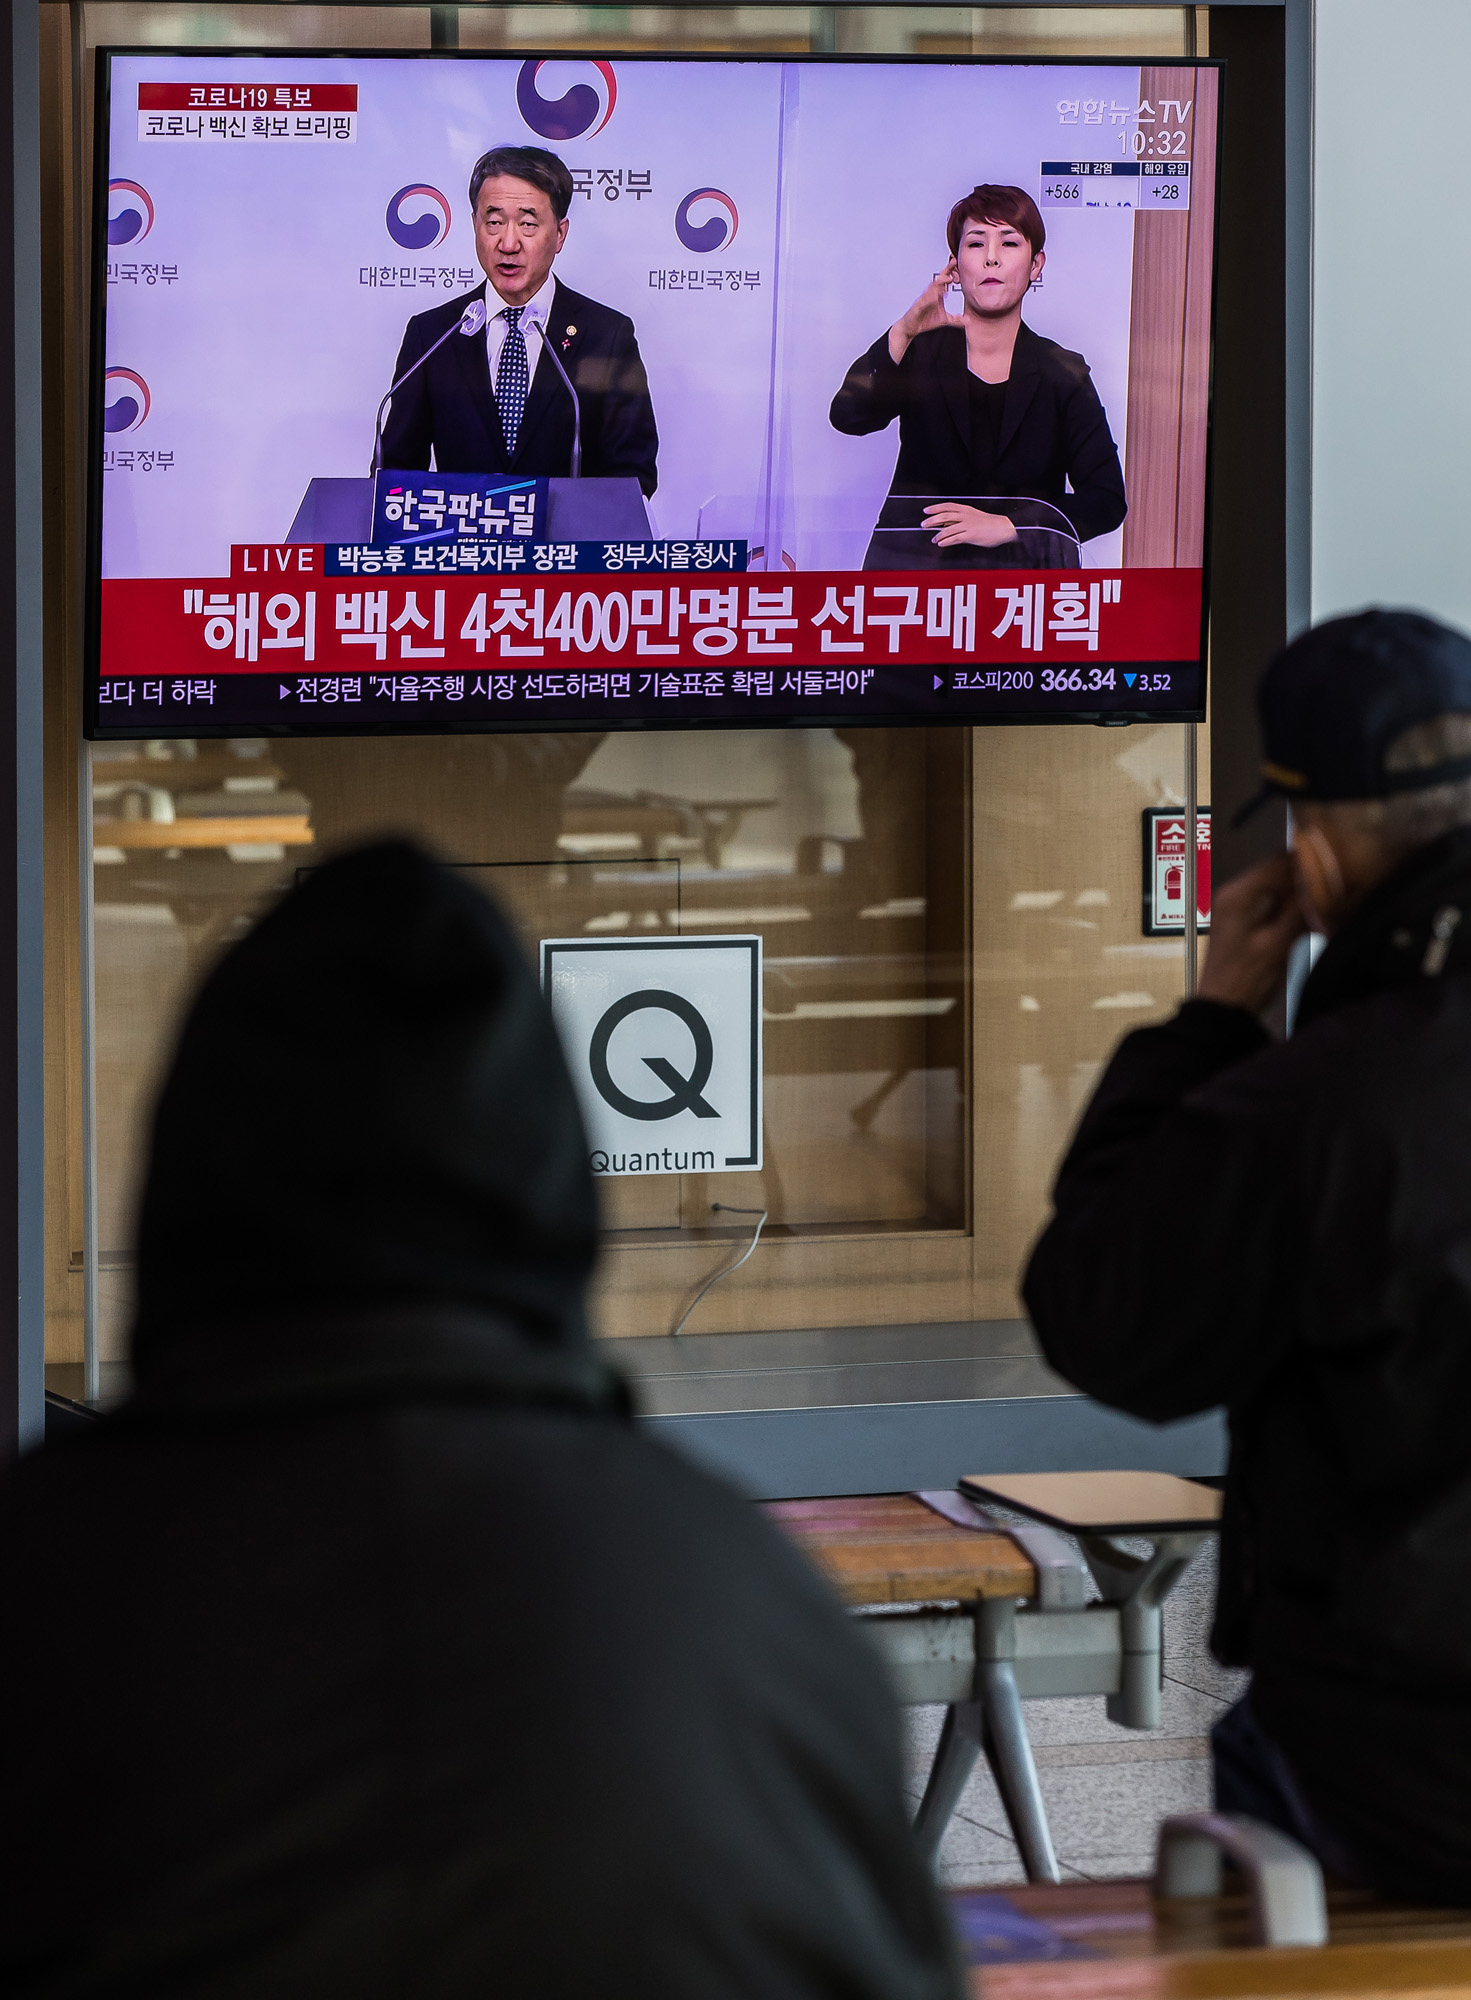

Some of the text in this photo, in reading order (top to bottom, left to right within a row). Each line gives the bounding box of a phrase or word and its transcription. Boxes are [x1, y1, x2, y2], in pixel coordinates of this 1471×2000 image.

[188, 87, 312, 109] 코로나19 특보
[1056, 99, 1192, 125] 연합뉴스TV
[145, 116, 351, 139] 코로나 백신 확보 브리핑
[1117, 130, 1187, 155] 10:32
[1070, 163, 1113, 175] 국내 감염
[1144, 163, 1187, 175] 해외 유입
[1045, 184, 1080, 199] +566
[1152, 185, 1179, 199] +28
[359, 266, 475, 289] 대한민국정부
[648, 268, 761, 291] 대한민국정부
[385, 487, 536, 536] 한국판뉴딜
[243, 548, 314, 572] LIVE
[337, 542, 737, 573] 박능후 보건복지부 장관 정부서울청사
[183, 579, 1122, 662] "해외 백신 4천400만명분 선구매 계획"
[295, 669, 875, 703] 전경련 "자율주행 시장 선도하려면 기술표준 확립 서둘러야"
[952, 668, 1171, 692] 코스피200 366.34 3.52
[143, 680, 162, 706] 더
[171, 679, 217, 705] 하락
[1161, 844, 1181, 852] FIRE
[589, 988, 722, 1122] Q
[589, 1148, 715, 1173] Quantum
